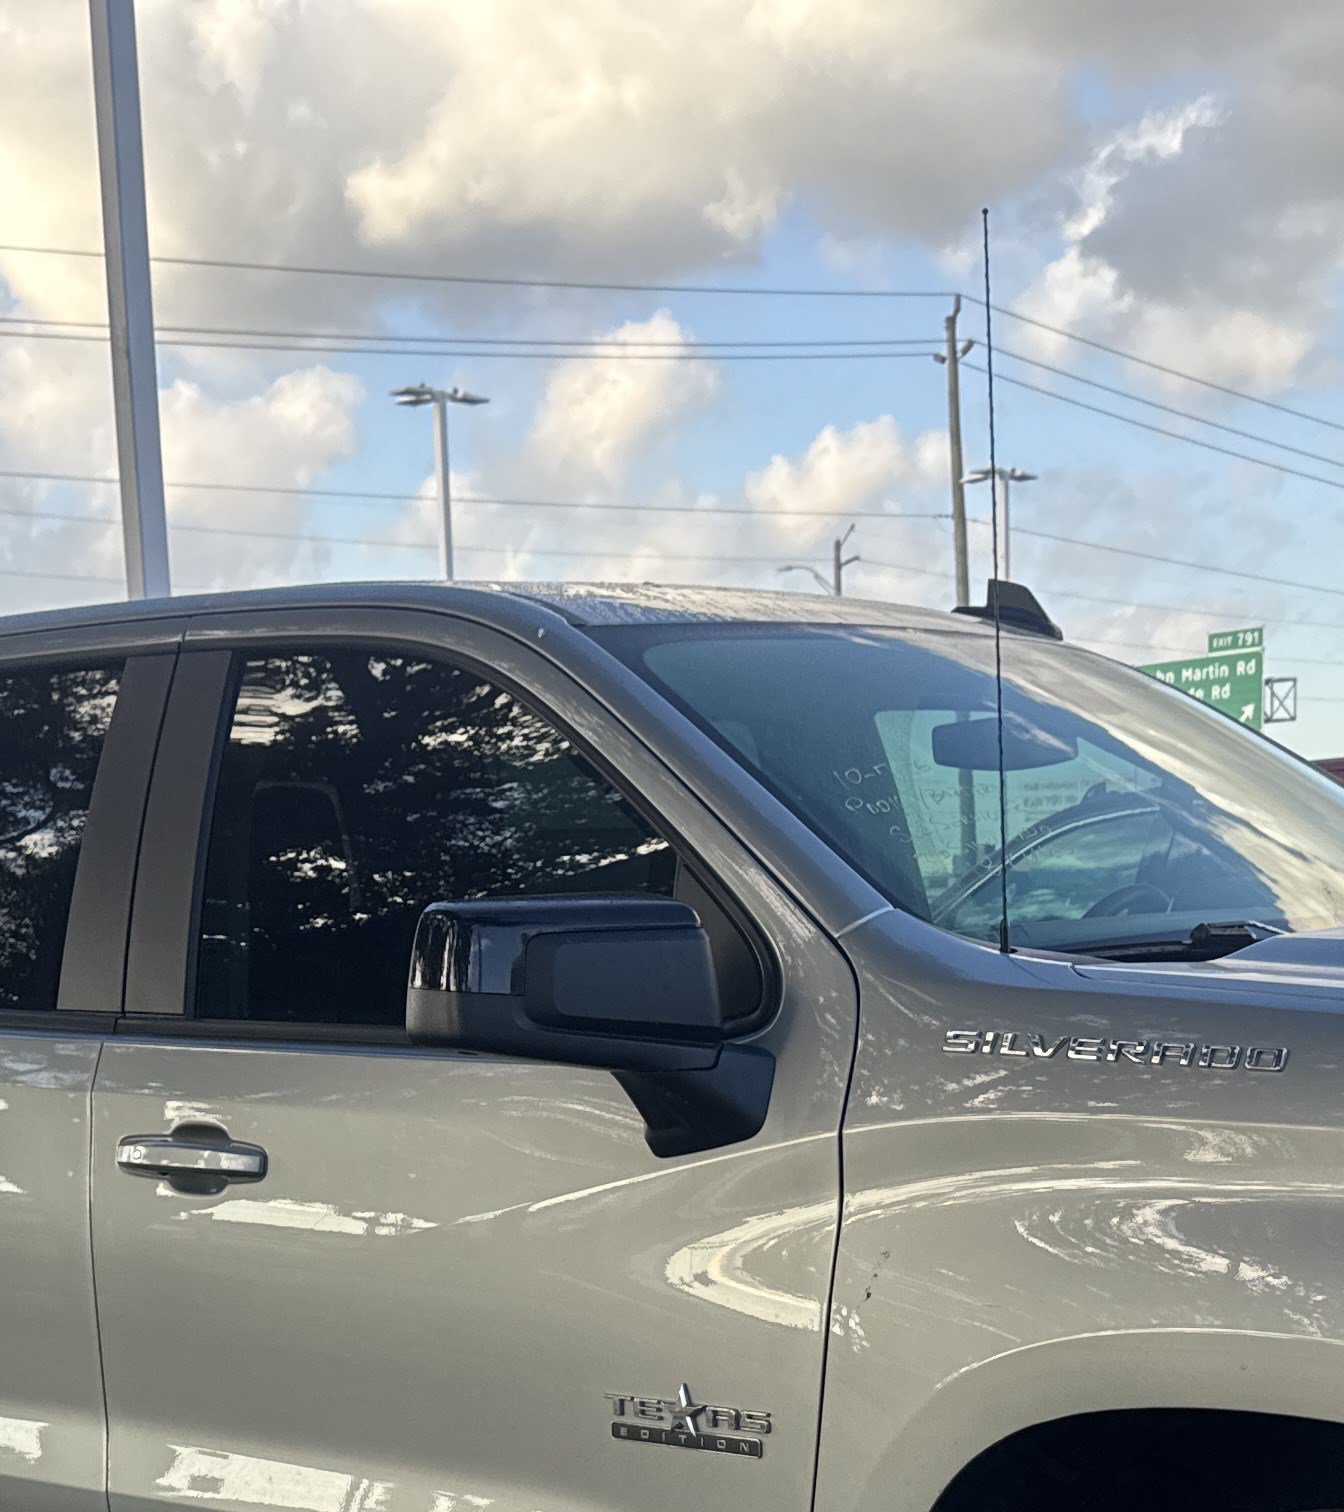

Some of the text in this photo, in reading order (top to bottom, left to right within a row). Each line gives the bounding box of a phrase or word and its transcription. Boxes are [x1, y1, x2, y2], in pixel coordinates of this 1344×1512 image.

[1212, 631, 1259, 648] EXIT 791
[1181, 662, 1229, 683] Martin
[1236, 659, 1256, 676] Rd
[1211, 683, 1231, 700] Rd
[942, 1029, 1290, 1073] SILVERADO
[619, 1427, 750, 1453] EDITION
